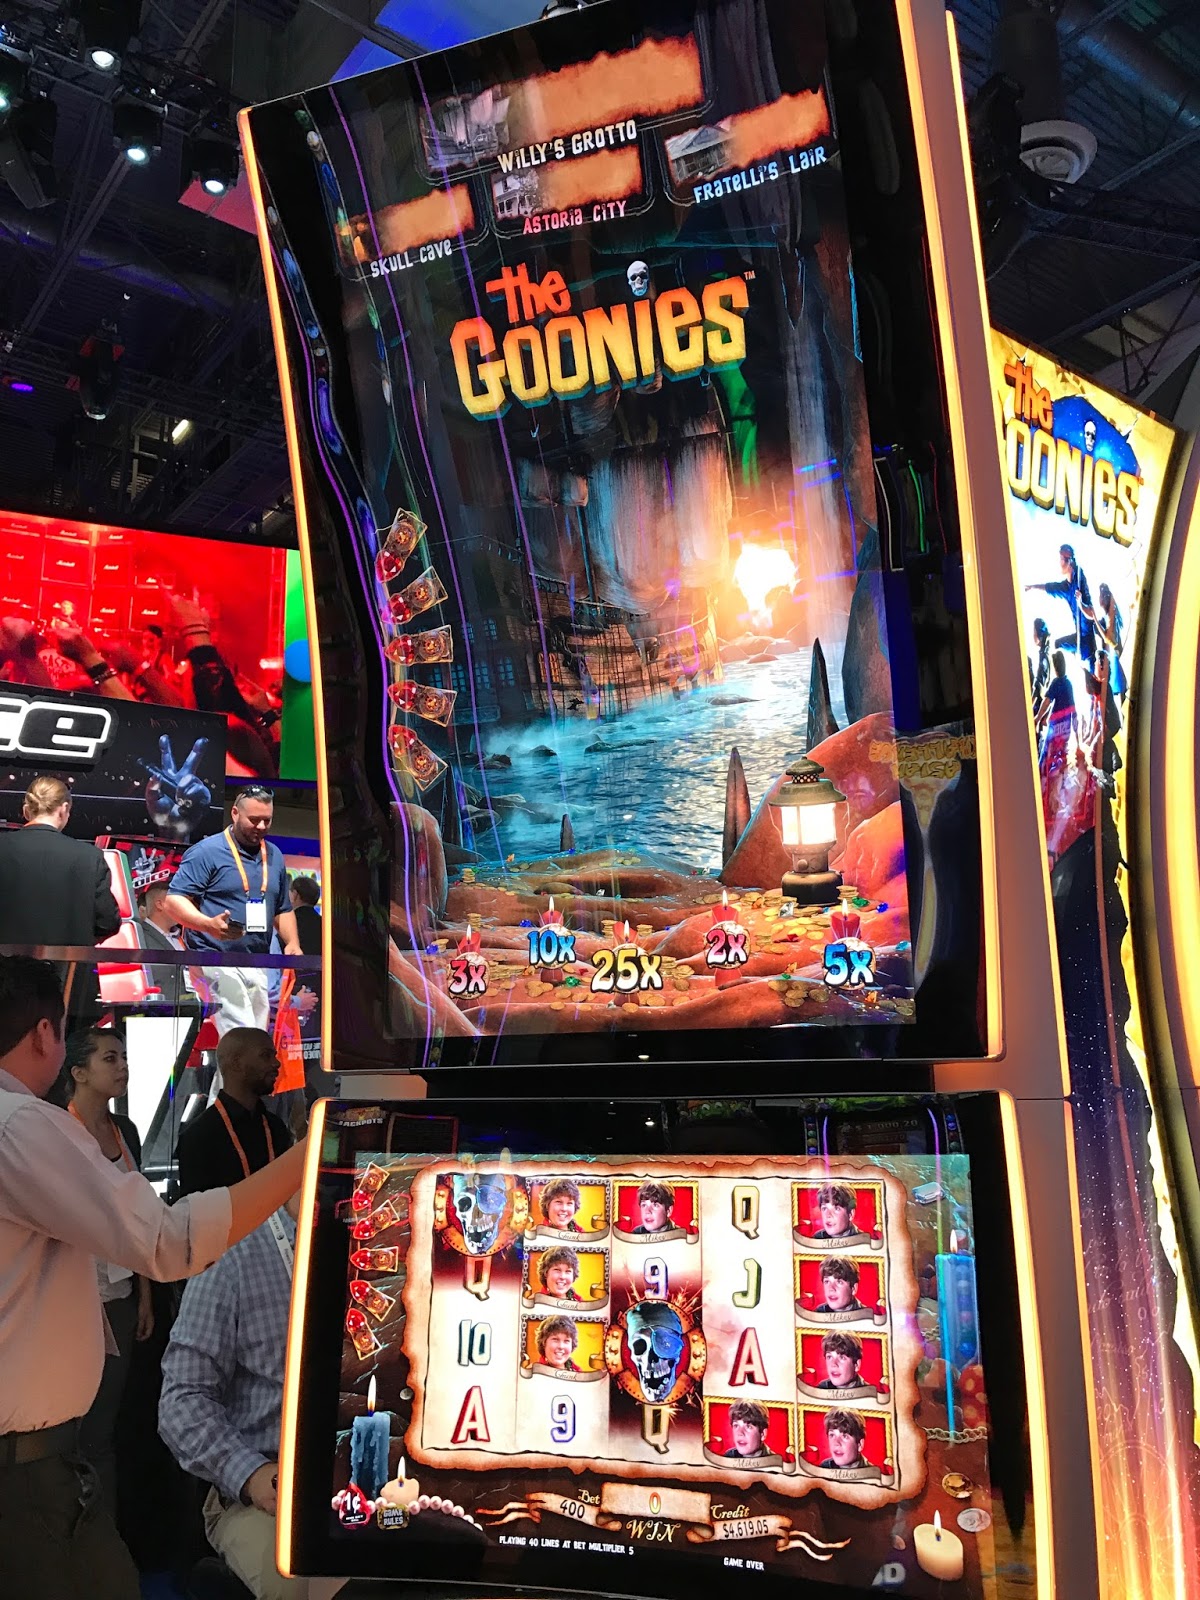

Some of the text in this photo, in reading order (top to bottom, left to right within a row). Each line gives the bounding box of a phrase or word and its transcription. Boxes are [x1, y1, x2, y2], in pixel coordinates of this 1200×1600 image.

[571, 119, 638, 156] GROTTO
[370, 255, 415, 278] SKULL
[485, 262, 572, 323] the
[1004, 361, 1053, 430] the
[731, 1185, 759, 1239] Q
[643, 1257, 668, 1299] 9
[732, 1258, 762, 1308] J
[458, 1319, 492, 1366] 10
[728, 1327, 769, 1386] A
[450, 1386, 490, 1443] A
[551, 1395, 576, 1443] 9
[560, 1500, 586, 1519] 400
[578, 1489, 600, 1504] Bet
[649, 1492, 662, 1514] 0
[711, 1505, 749, 1519] Credit
[383, 1517, 404, 1526] RULES
[626, 1519, 681, 1543] WIN
[499, 1536, 634, 1555] PLAYING 40 LINES AT BET MULTIPLIER 5
[723, 1557, 765, 1570] GAME OVER
